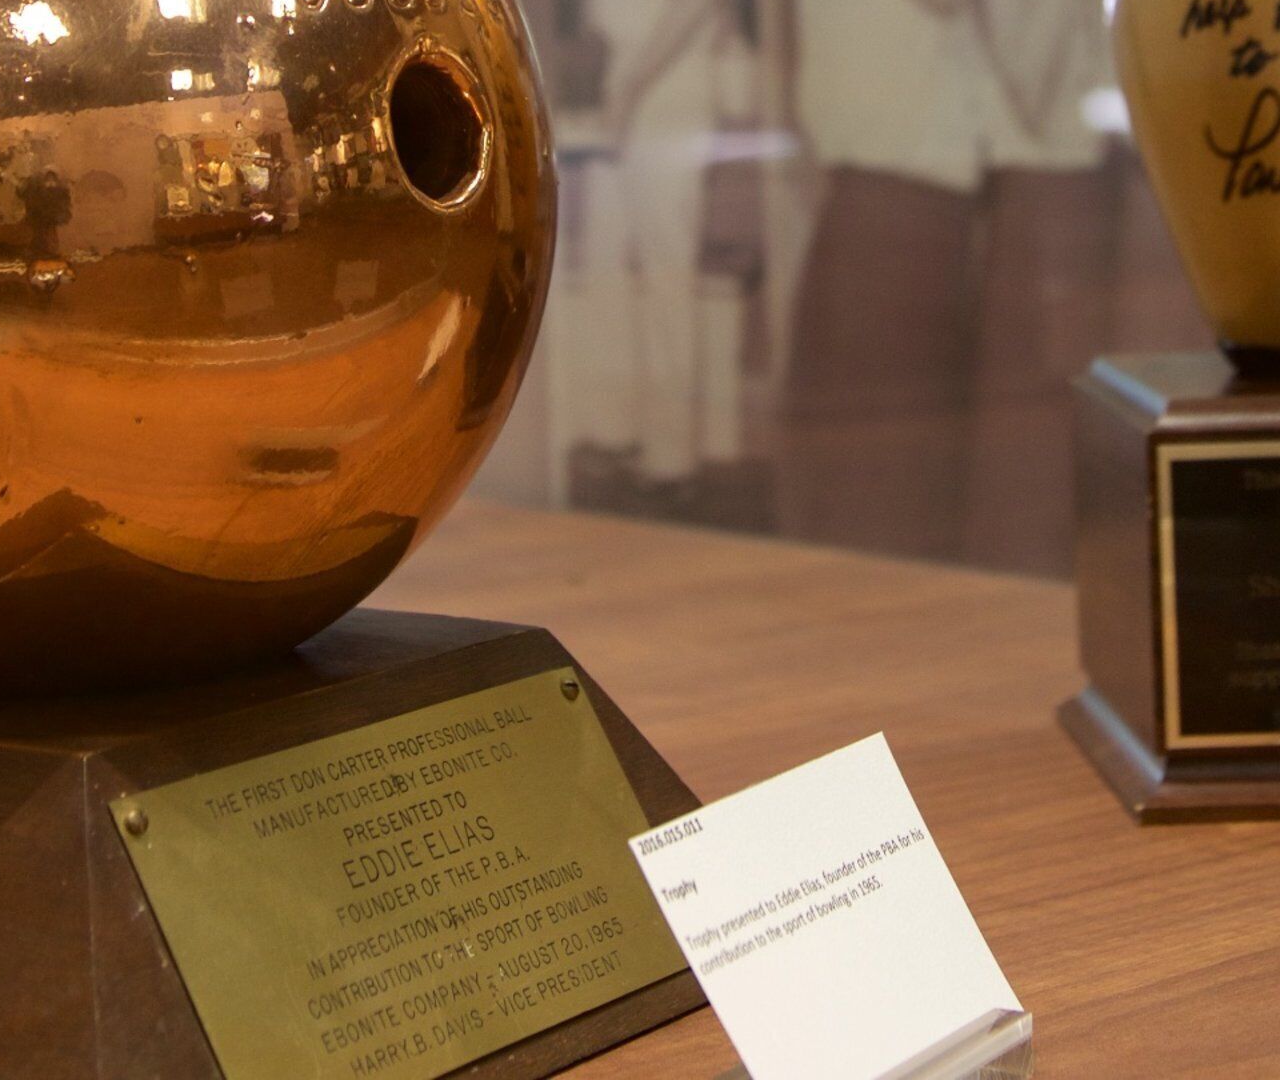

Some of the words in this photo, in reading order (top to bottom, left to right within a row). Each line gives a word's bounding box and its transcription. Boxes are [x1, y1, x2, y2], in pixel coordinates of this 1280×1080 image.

[1229, 38, 1279, 77] to
[204, 793, 242, 820] THE
[241, 778, 288, 809] FIRST
[290, 768, 326, 794] DON
[327, 748, 388, 782] CARTER
[387, 717, 495, 762] PROFESSIONAL
[493, 705, 533, 729] BALL
[253, 779, 395, 839] MANUFACTURED
[397, 771, 418, 794] BY
[420, 749, 490, 786] EBONITE
[490, 742, 519, 763] CO.
[342, 798, 444, 847] PRESENTED
[443, 791, 468, 812] TO
[342, 839, 423, 889] EDDIE
[422, 815, 495, 861] ELIAS
[638, 817, 704, 857] 2016.015.011
[306, 958, 326, 981] IN
[328, 917, 439, 973] APPRECIATION
[439, 906, 460, 930] OF
[462, 897, 488, 921] HIS
[488, 861, 583, 911] OUTSTANDING
[336, 882, 420, 929] FOUNDER
[421, 874, 442, 897] OF
[444, 861, 480, 887] THE
[661, 877, 699, 903] Trophy
[685, 926, 721, 951] Trophy
[721, 902, 766, 939] presented
[765, 899, 777, 914] to
[775, 886, 802, 909] Eddie
[799, 877, 826, 897] Elias,
[822, 860, 858, 888] founder
[857, 854, 869, 870] of
[866, 847, 883, 864] the
[880, 839, 900, 857] PBA
[897, 834, 912, 849] for
[909, 827, 925, 844] his
[699, 938, 757, 976] contribution
[755, 933, 768, 949] to
[766, 925, 783, 944] the
[782, 913, 808, 937] sport
[806, 905, 818, 923] of
[814, 892, 853, 918] bowling
[848, 887, 860, 902] in
[857, 875, 884, 897] 1965.
[307, 957, 422, 1020] CONTRIBUTION
[422, 950, 444, 973] TO
[444, 936, 475, 962] THE
[476, 917, 523, 952] SPORT
[524, 909, 545, 933] OF
[546, 885, 608, 924] BOWLING
[321, 1005, 401, 1054] EBONITE
[402, 971, 482, 1020] COMPANY
[498, 941, 560, 982] AUGUST
[588, 916, 624, 945] 1965
[350, 1037, 410, 1078] HARRY
[413, 1031, 432, 1055] B.
[432, 1008, 484, 1047] DAVIS
[496, 986, 538, 1018] VICE
[536, 949, 623, 1000] PRESIDENT
